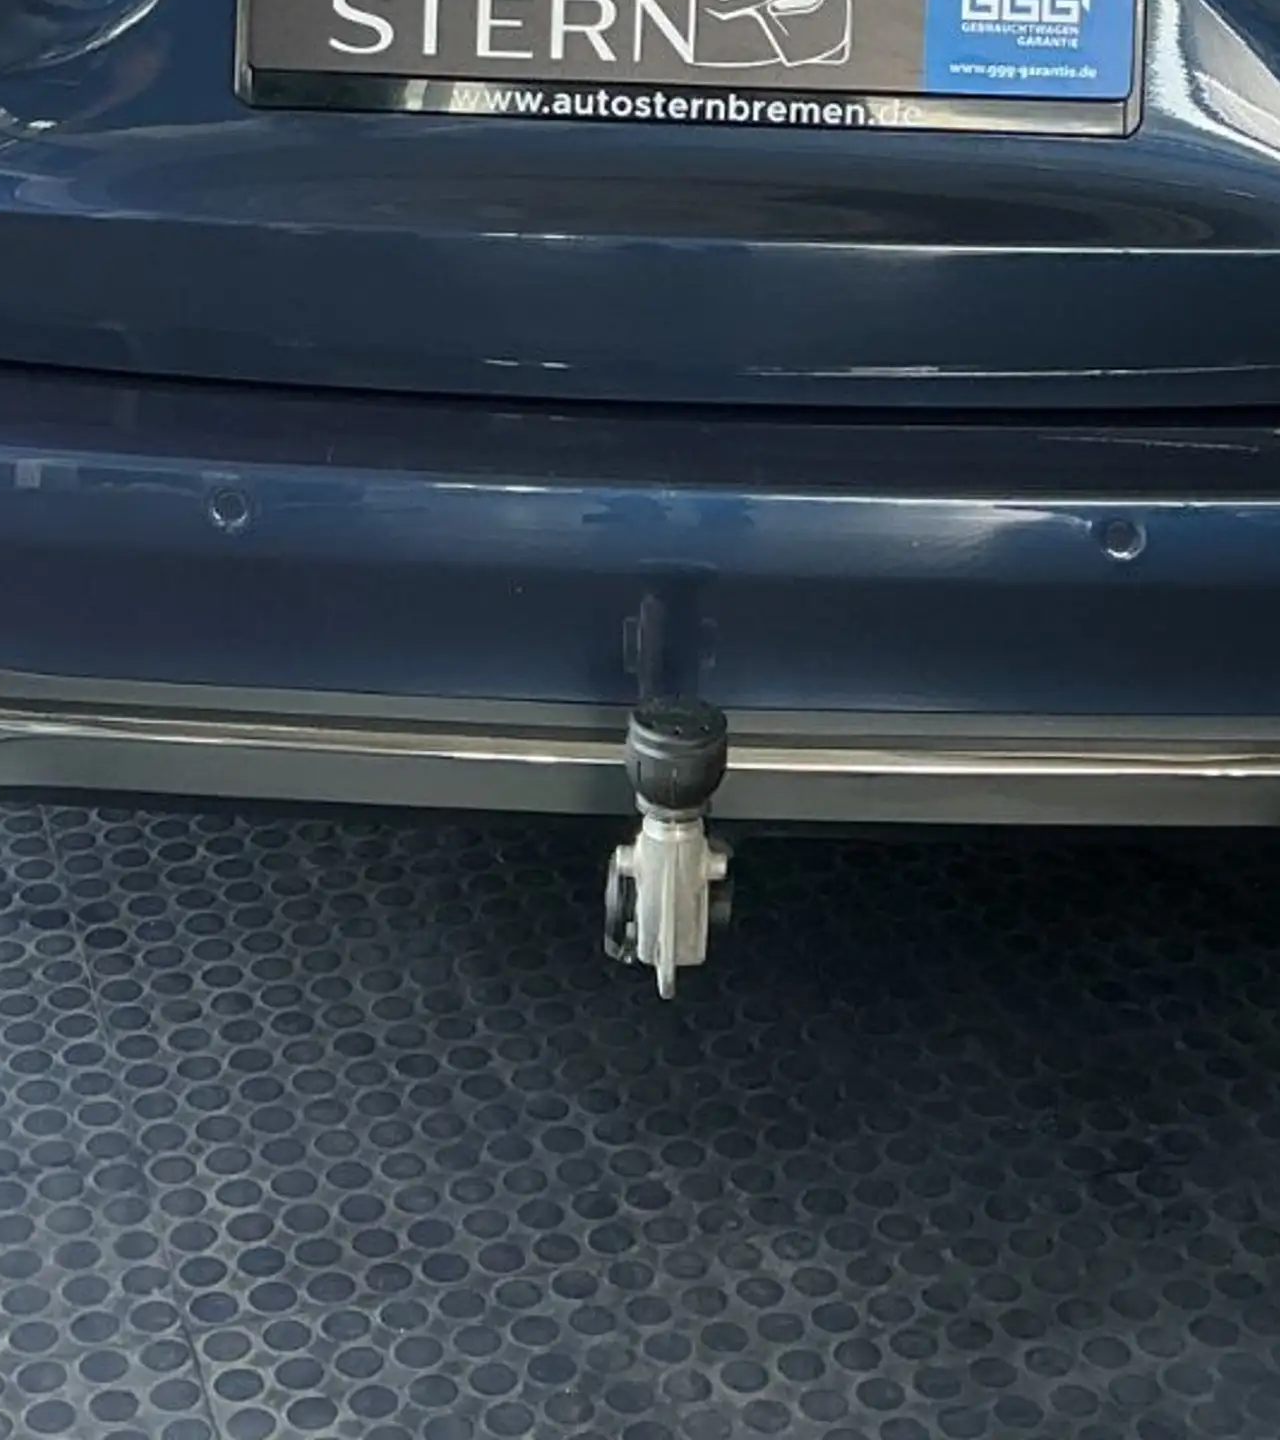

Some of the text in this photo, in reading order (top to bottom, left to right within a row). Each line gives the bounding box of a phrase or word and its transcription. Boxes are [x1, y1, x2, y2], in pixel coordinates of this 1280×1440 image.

[961, 22, 1080, 36] GEBRAUCHTWAGEN
[1017, 35, 1079, 49] GARANTIE
[949, 61, 1098, 79] www.ggg-garantie.de
[452, 88, 923, 126] www.autosternbremen.de
